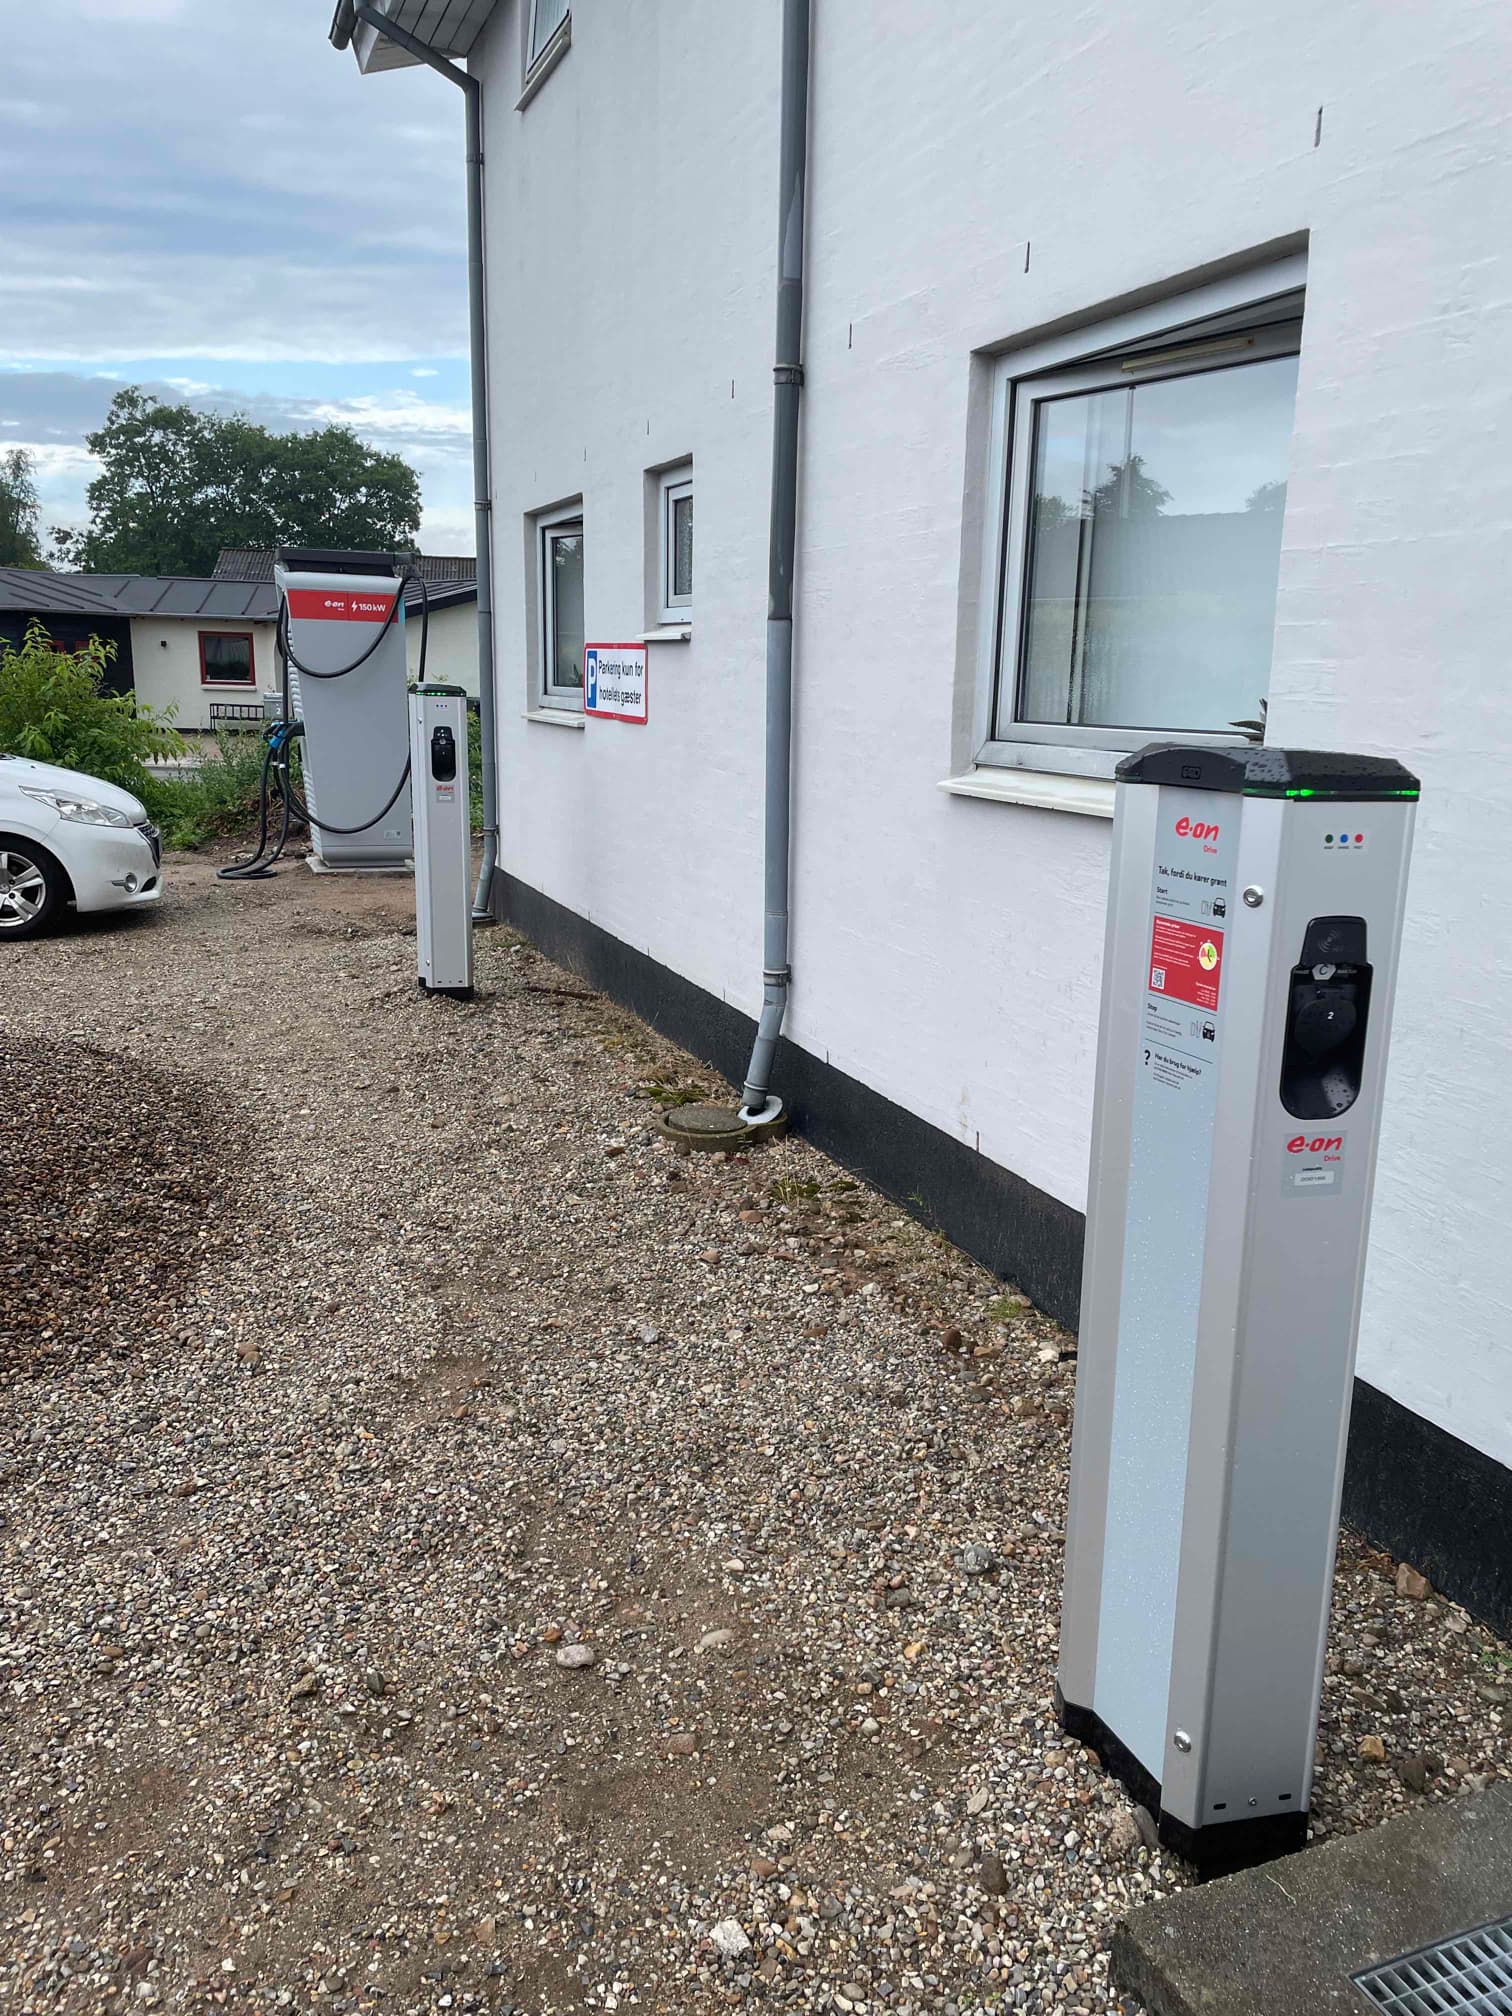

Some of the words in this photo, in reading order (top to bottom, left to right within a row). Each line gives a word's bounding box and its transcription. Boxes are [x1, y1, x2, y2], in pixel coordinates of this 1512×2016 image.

[598, 659, 621, 680] Parkering
[621, 661, 634, 676] kun
[635, 661, 643, 677] for
[588, 658, 597, 699] P
[599, 686, 621, 702] hotellets
[621, 690, 641, 707] gæster
[1185, 869, 1193, 880] du
[1156, 886, 1168, 894] Start
[1327, 1011, 1334, 1020] 2
